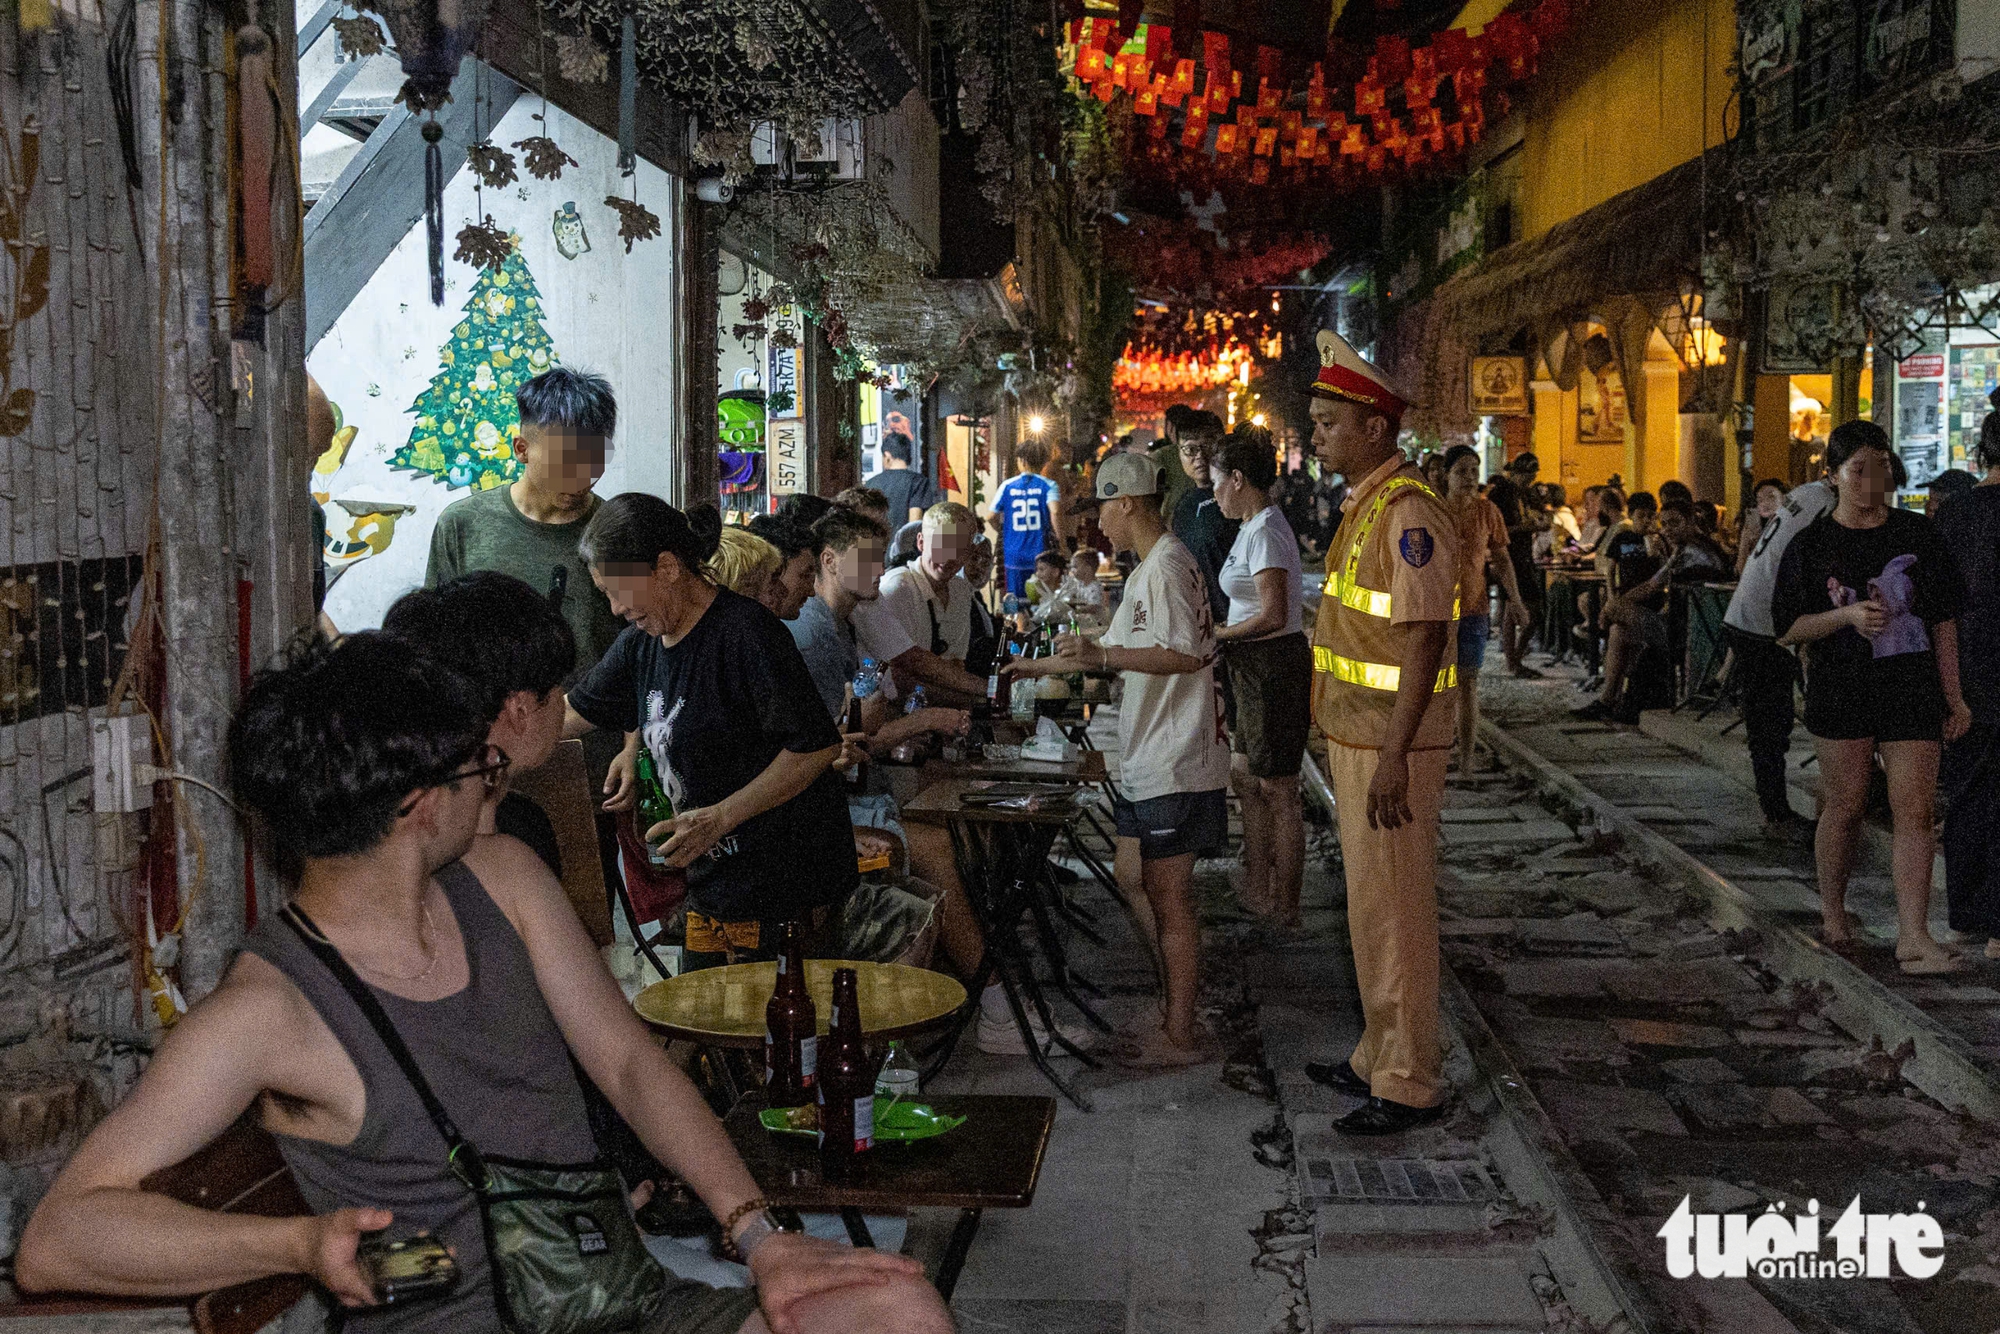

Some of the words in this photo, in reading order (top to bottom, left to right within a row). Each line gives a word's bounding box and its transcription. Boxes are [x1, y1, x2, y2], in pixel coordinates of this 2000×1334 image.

[778, 428, 796, 459] AZM
[778, 463, 796, 487] 557
[1012, 498, 1042, 531] 26
